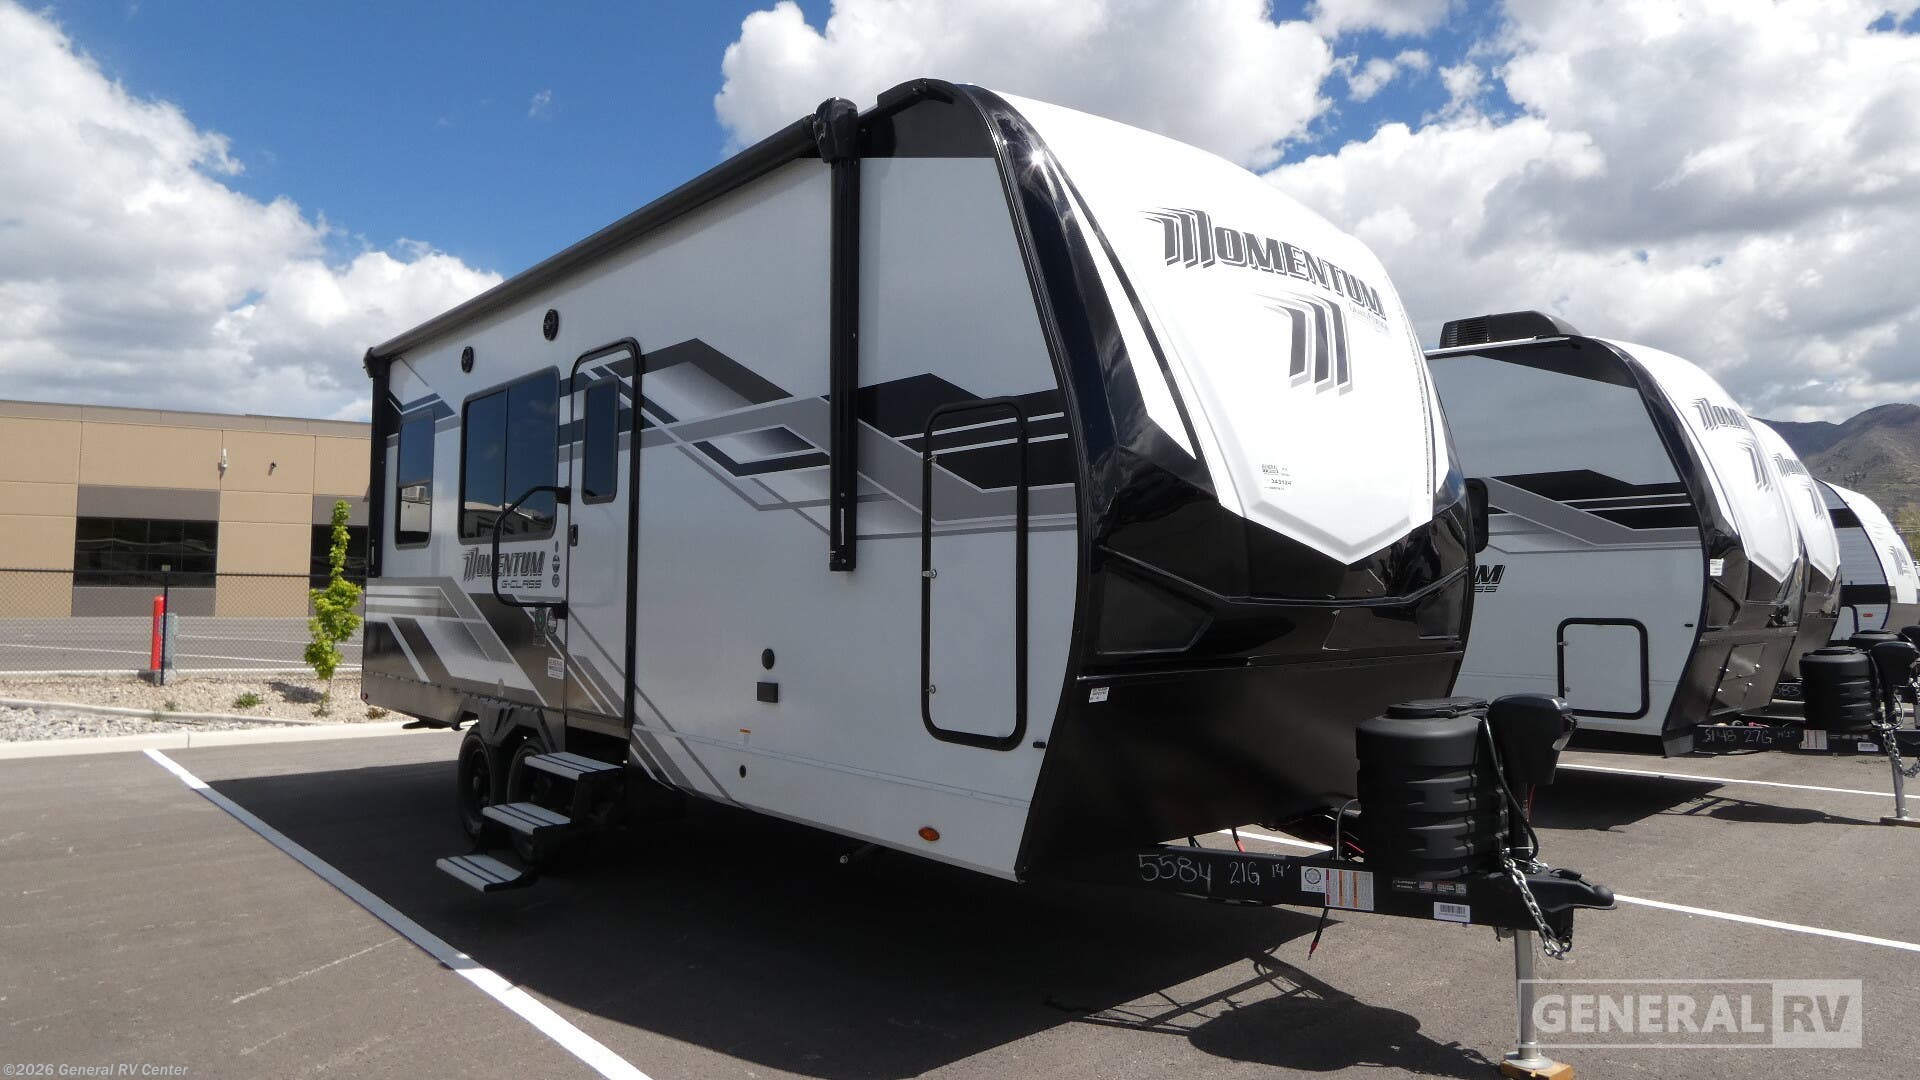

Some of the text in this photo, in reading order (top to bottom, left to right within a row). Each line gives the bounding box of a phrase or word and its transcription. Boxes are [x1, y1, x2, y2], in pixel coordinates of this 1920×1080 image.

[1141, 206, 1387, 321] MOMENTUM
[501, 579, 542, 589] G-CLASS
[1138, 854, 1212, 893] 5584
[1229, 861, 1260, 885] 21G
